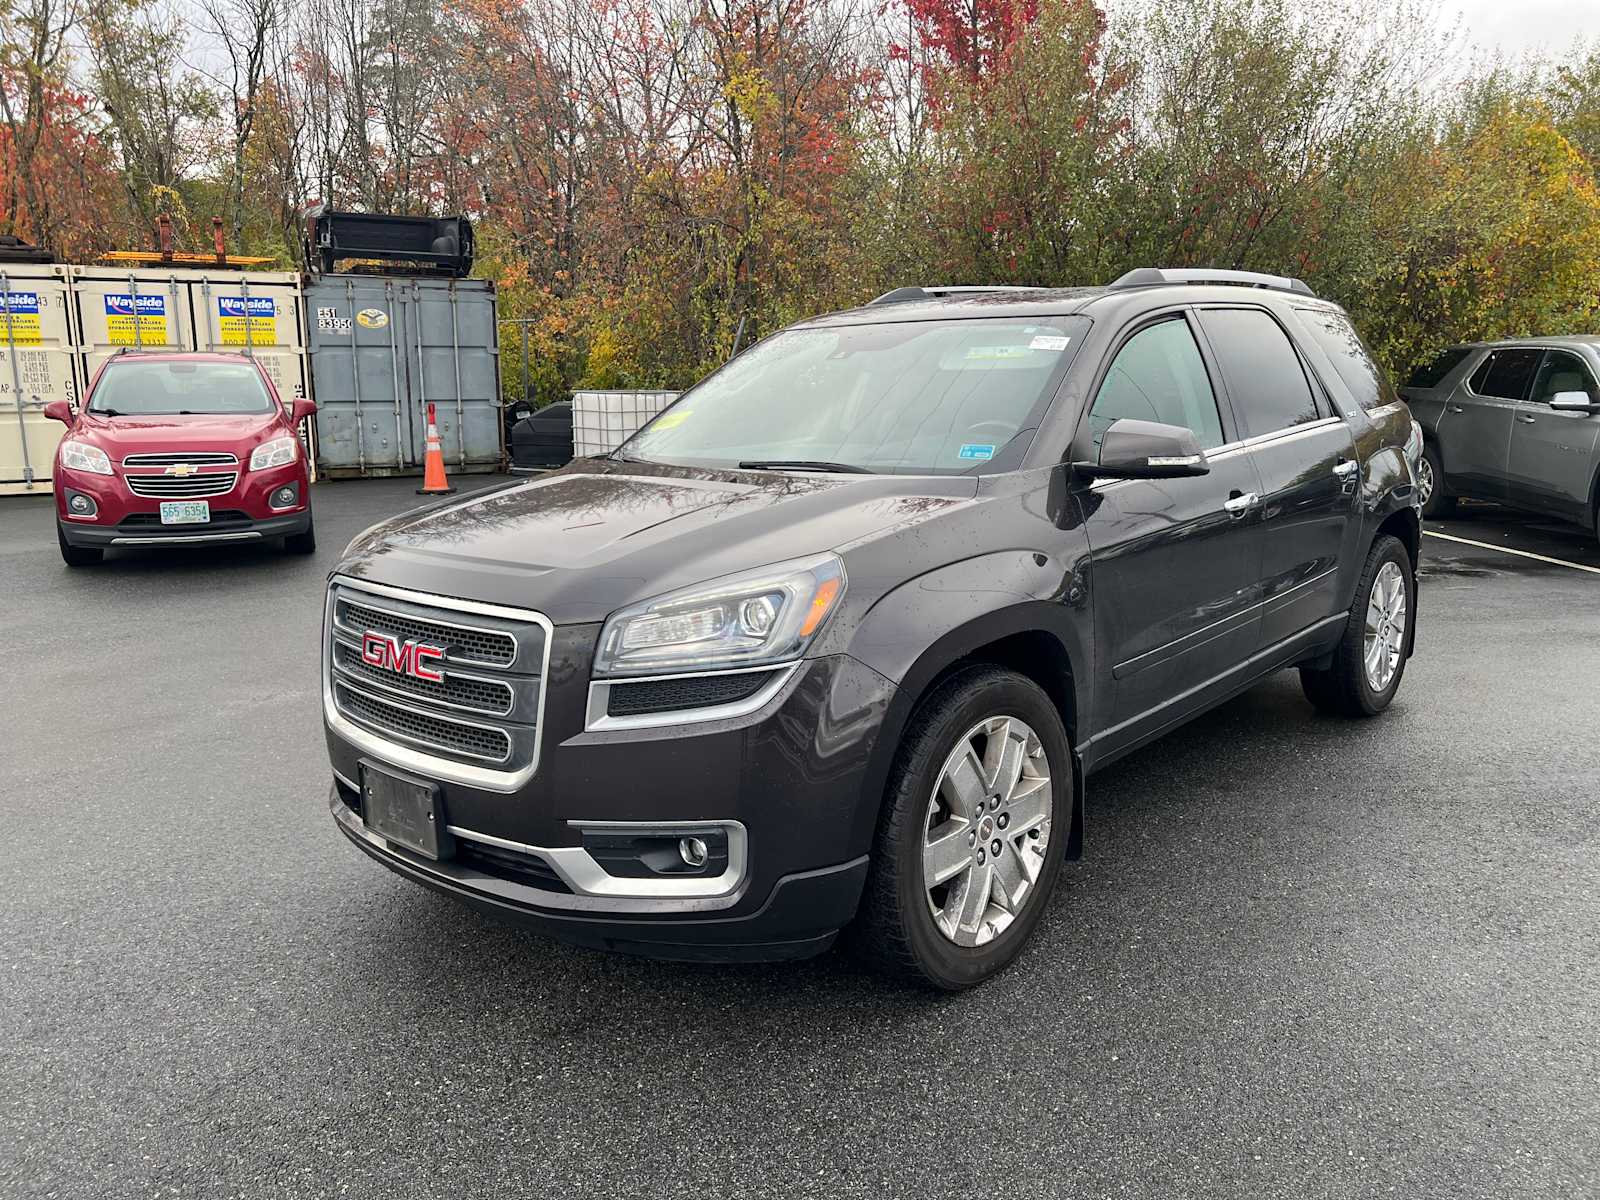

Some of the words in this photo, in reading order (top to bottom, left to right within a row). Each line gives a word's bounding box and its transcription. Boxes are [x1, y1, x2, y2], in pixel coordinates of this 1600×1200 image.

[106, 296, 163, 309] Wayside
[220, 298, 273, 310] Wayside
[361, 630, 447, 683] GMC
